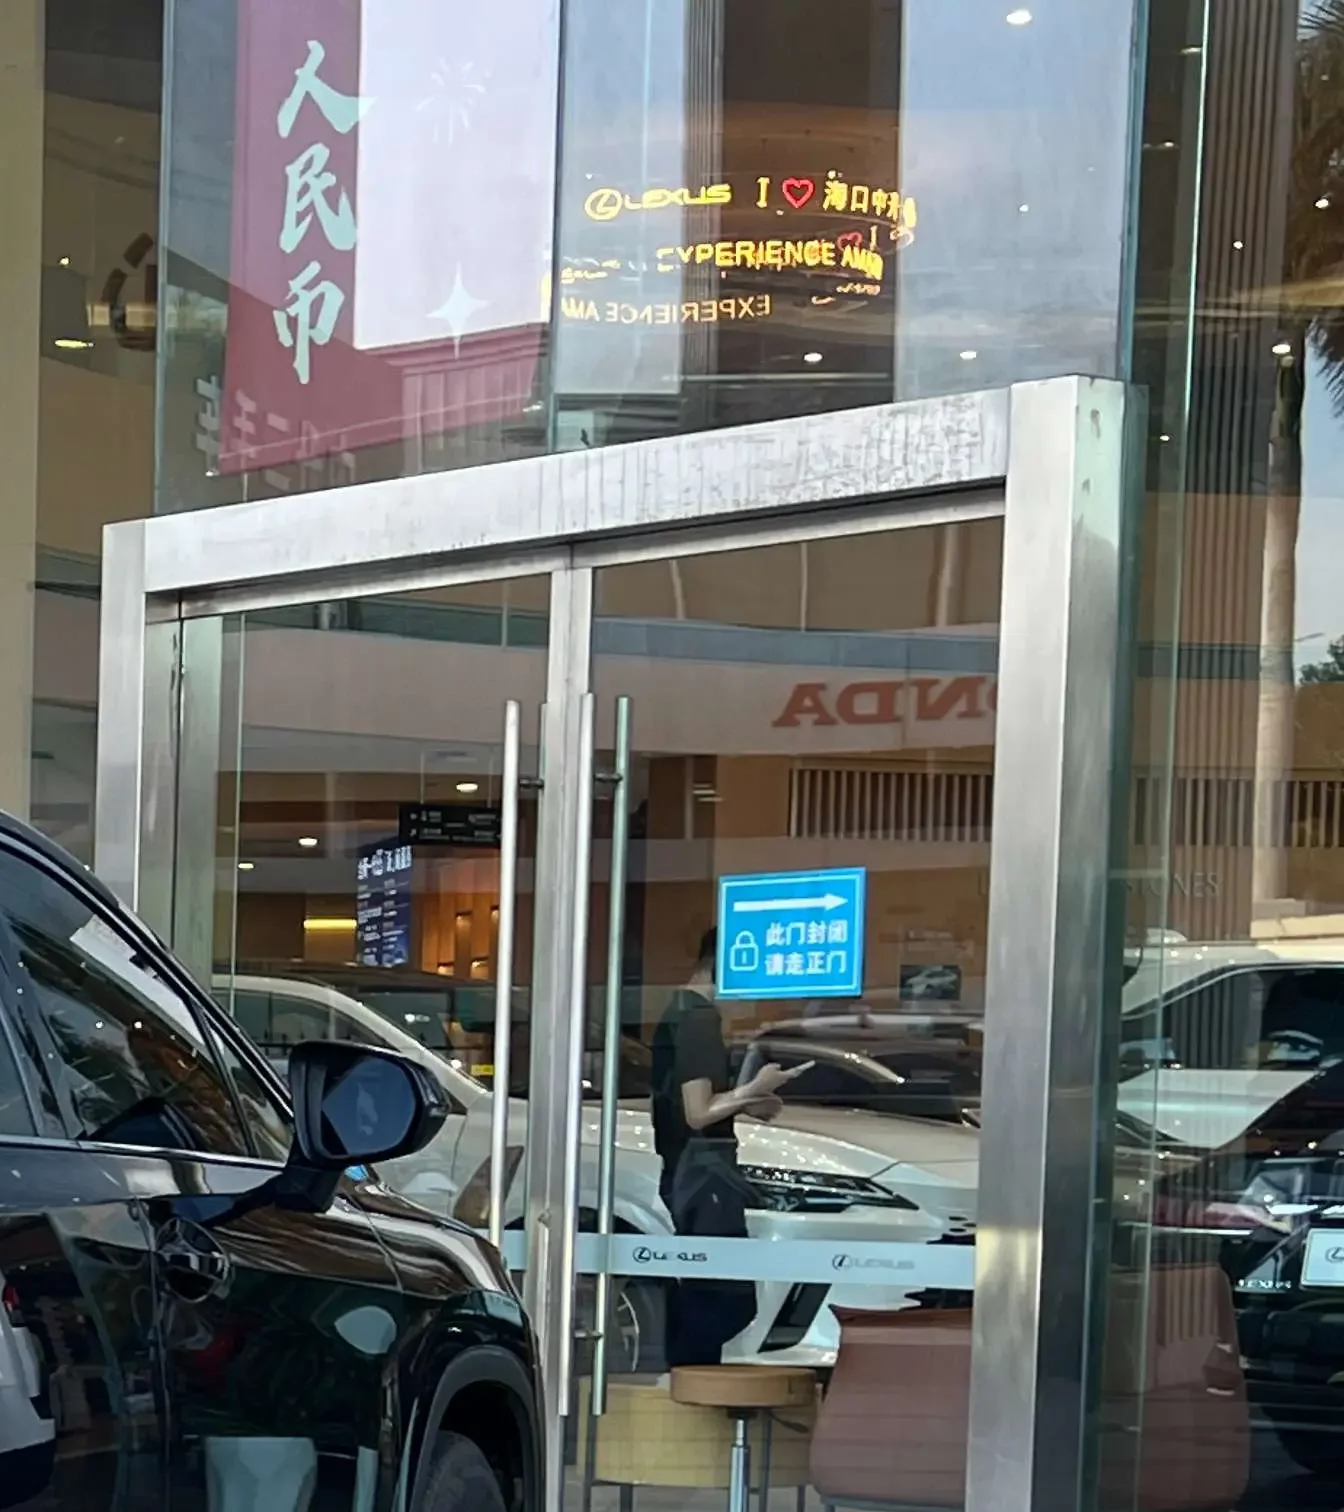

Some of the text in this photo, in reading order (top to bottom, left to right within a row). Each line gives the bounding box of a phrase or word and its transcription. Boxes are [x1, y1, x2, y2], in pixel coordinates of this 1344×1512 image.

[624, 184, 732, 211] LEXUS
[765, 919, 848, 946] 此门封闭
[764, 950, 847, 976] 请走正门
